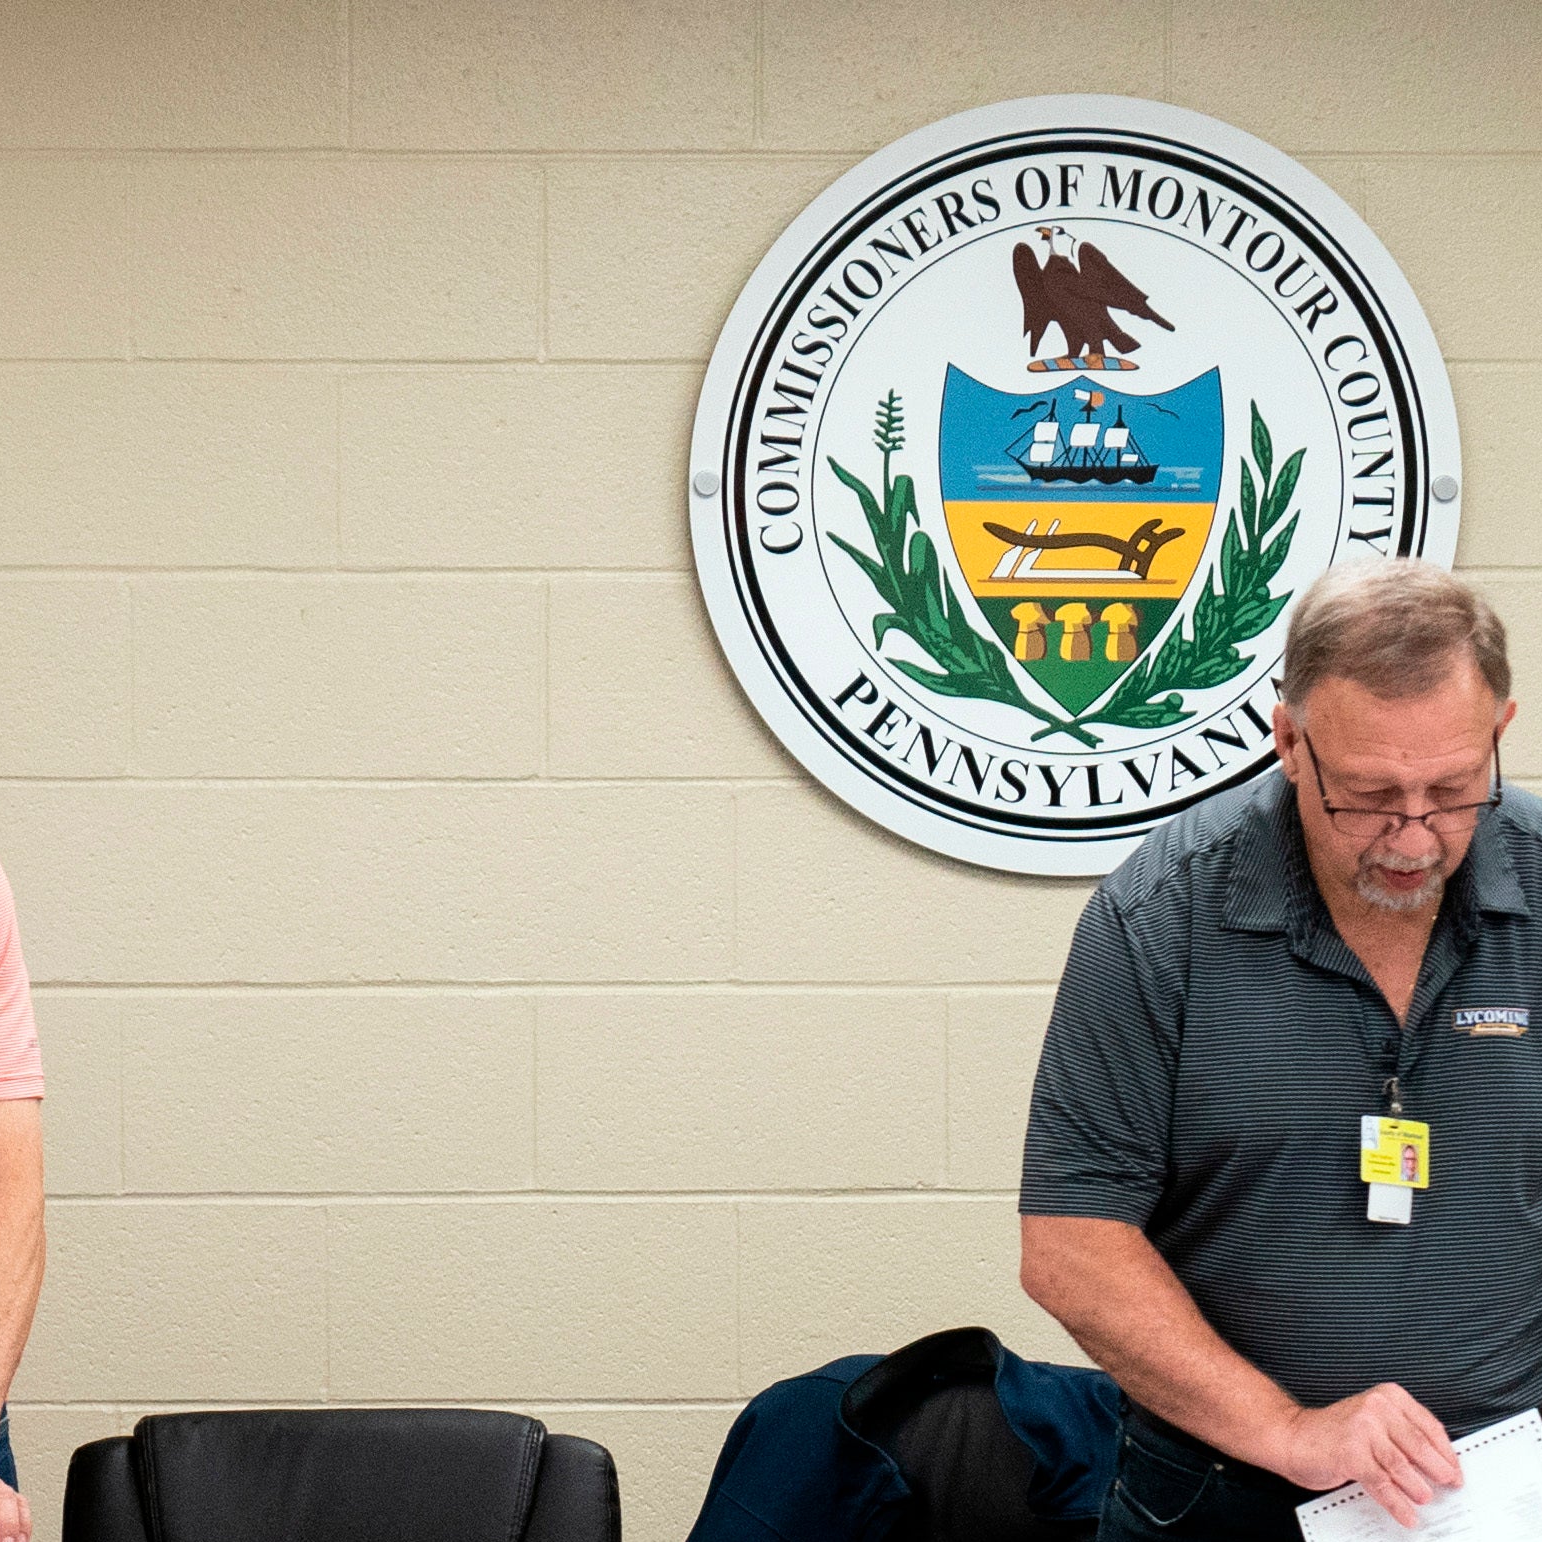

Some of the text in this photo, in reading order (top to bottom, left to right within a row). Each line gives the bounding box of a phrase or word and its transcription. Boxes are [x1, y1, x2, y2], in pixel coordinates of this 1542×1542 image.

[757, 163, 1396, 557] COMMISSIONERS OF MONTOUR COUNTY
[831, 670, 1284, 809] PENNSYLVANI
